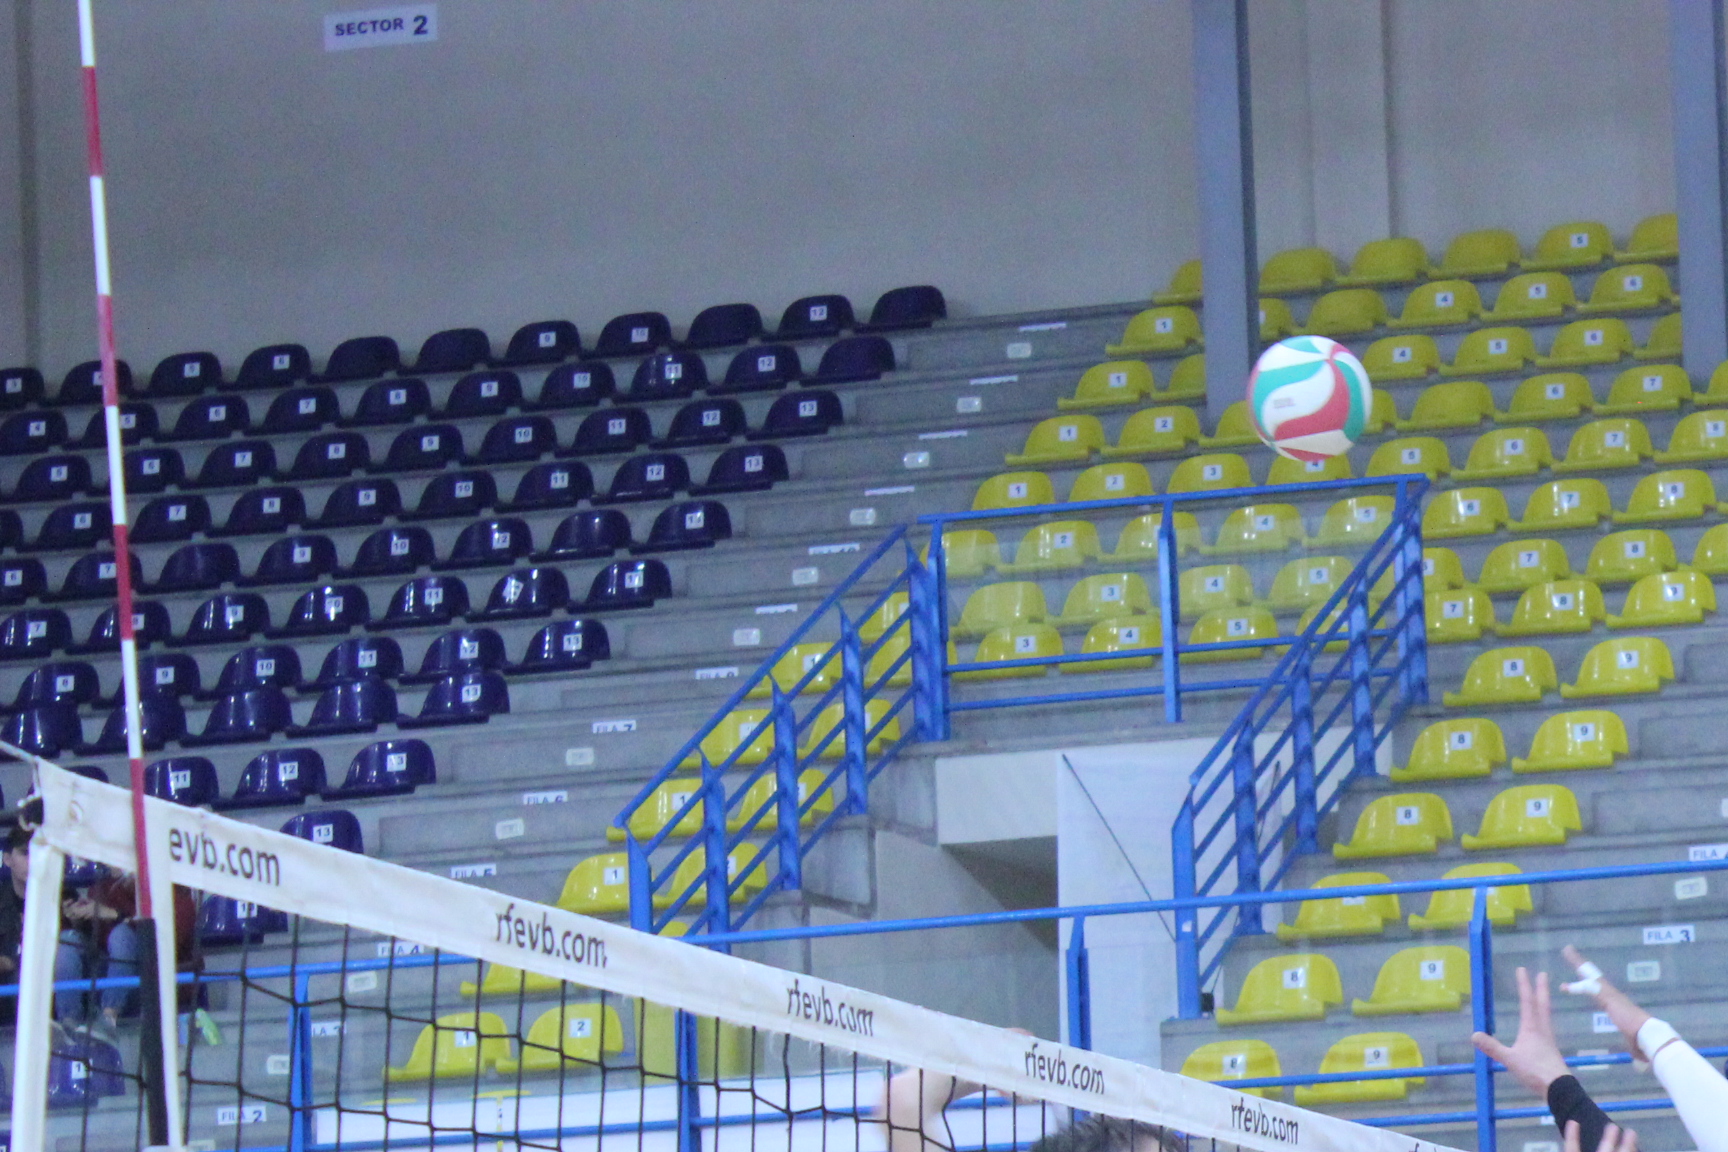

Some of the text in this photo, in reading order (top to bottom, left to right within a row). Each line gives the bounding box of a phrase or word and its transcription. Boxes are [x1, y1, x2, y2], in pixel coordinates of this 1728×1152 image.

[335, 15, 429, 36] SECTOR 2
[760, 358, 773, 368] 12
[801, 403, 815, 412] 13
[517, 429, 530, 438] 10
[649, 467, 662, 476] 12
[553, 474, 565, 484] 11
[458, 483, 471, 493] 10
[260, 661, 273, 671] 10
[282, 764, 296, 775] 12
[316, 827, 331, 837] 13
[168, 826, 282, 886] evb.com
[495, 910, 608, 969] rfevb.com
[1646, 928, 1691, 943] FILA 3
[785, 978, 875, 1038] rfevb.com
[1023, 1043, 1106, 1097] rfevb.com
[1229, 1098, 1300, 1146] rfevb.com
